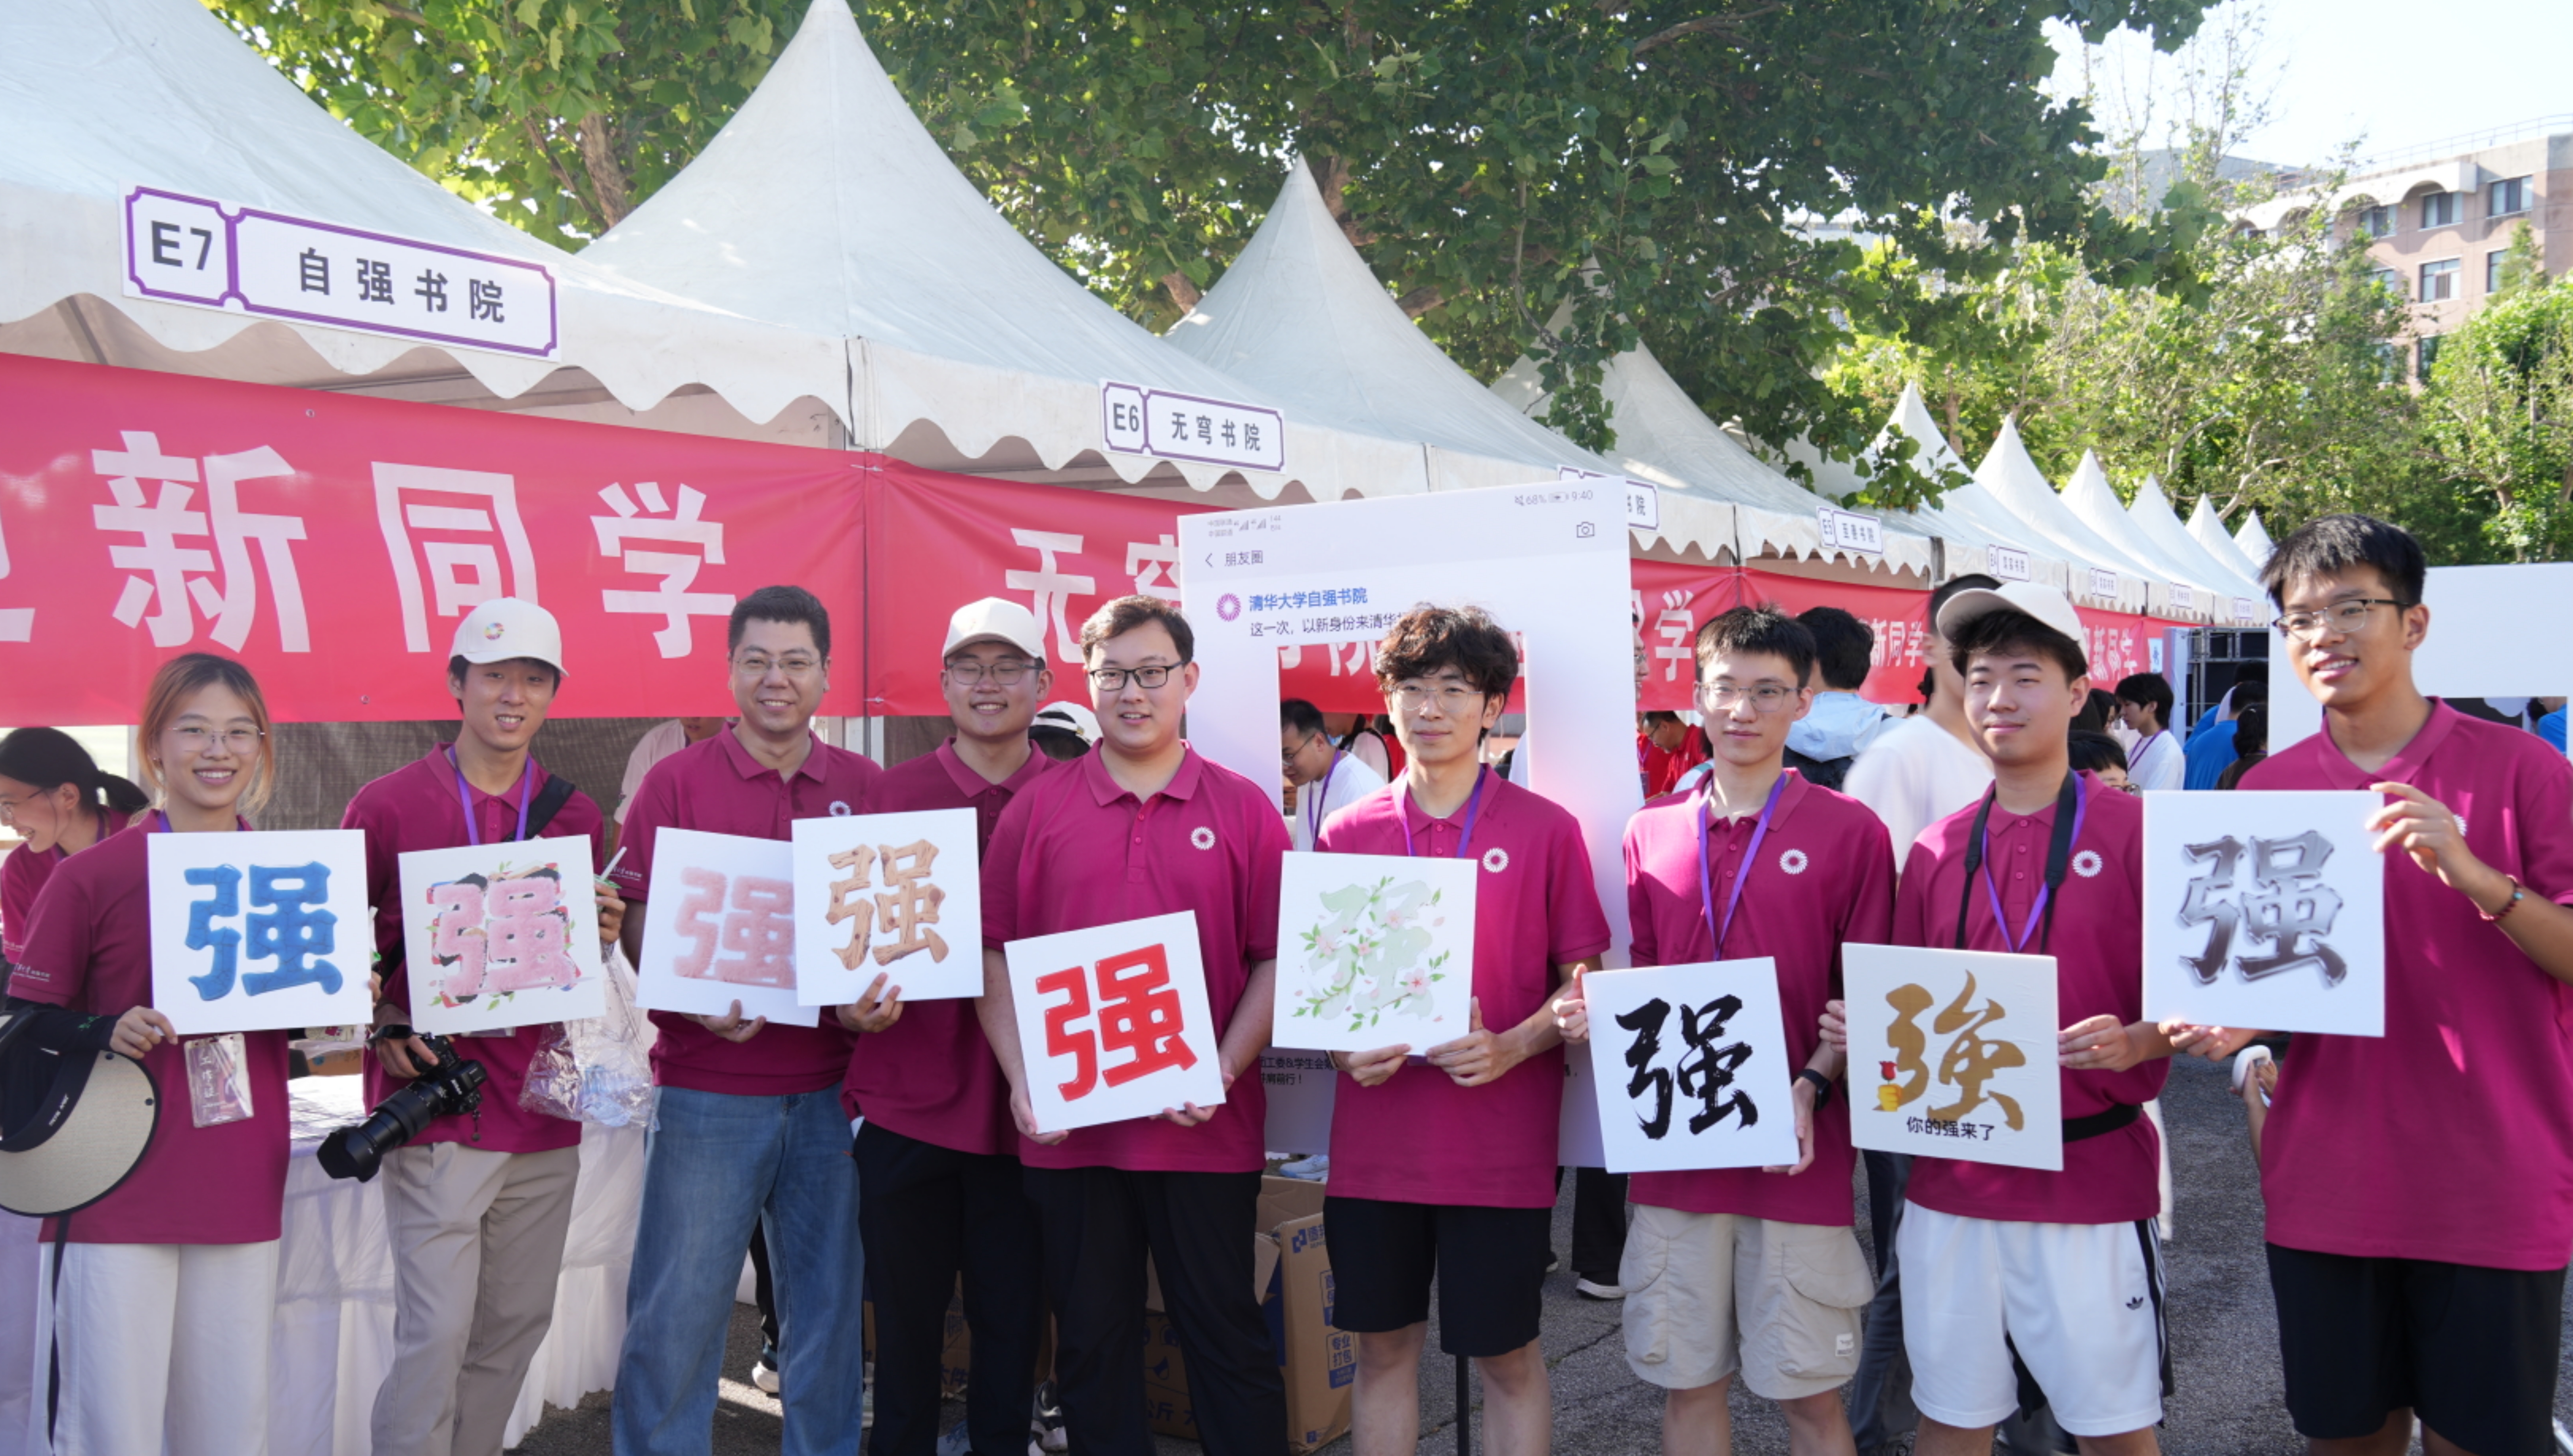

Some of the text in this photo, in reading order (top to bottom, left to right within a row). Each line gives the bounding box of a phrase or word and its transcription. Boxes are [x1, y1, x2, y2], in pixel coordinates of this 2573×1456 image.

[150, 220, 213, 271] E7
[298, 248, 506, 323] 自强书院
[1113, 403, 1139, 432] E6
[1171, 412, 1260, 451] 无穹书院
[0, 431, 736, 659] 新同学
[1572, 490, 1593, 502] 9:40
[1225, 550, 1263, 566] 朋友圈
[1250, 588, 1368, 612] 清华大学自强书院
[184, 861, 343, 1000] 强
[430, 870, 579, 1003] 强
[674, 867, 793, 990] 强
[825, 839, 949, 971] 强
[2178, 830, 2347, 987] 强
[1036, 943, 1198, 1102] 强
[1615, 995, 1758, 1140] 强
[1907, 1116, 1994, 1141] 你的强来了
